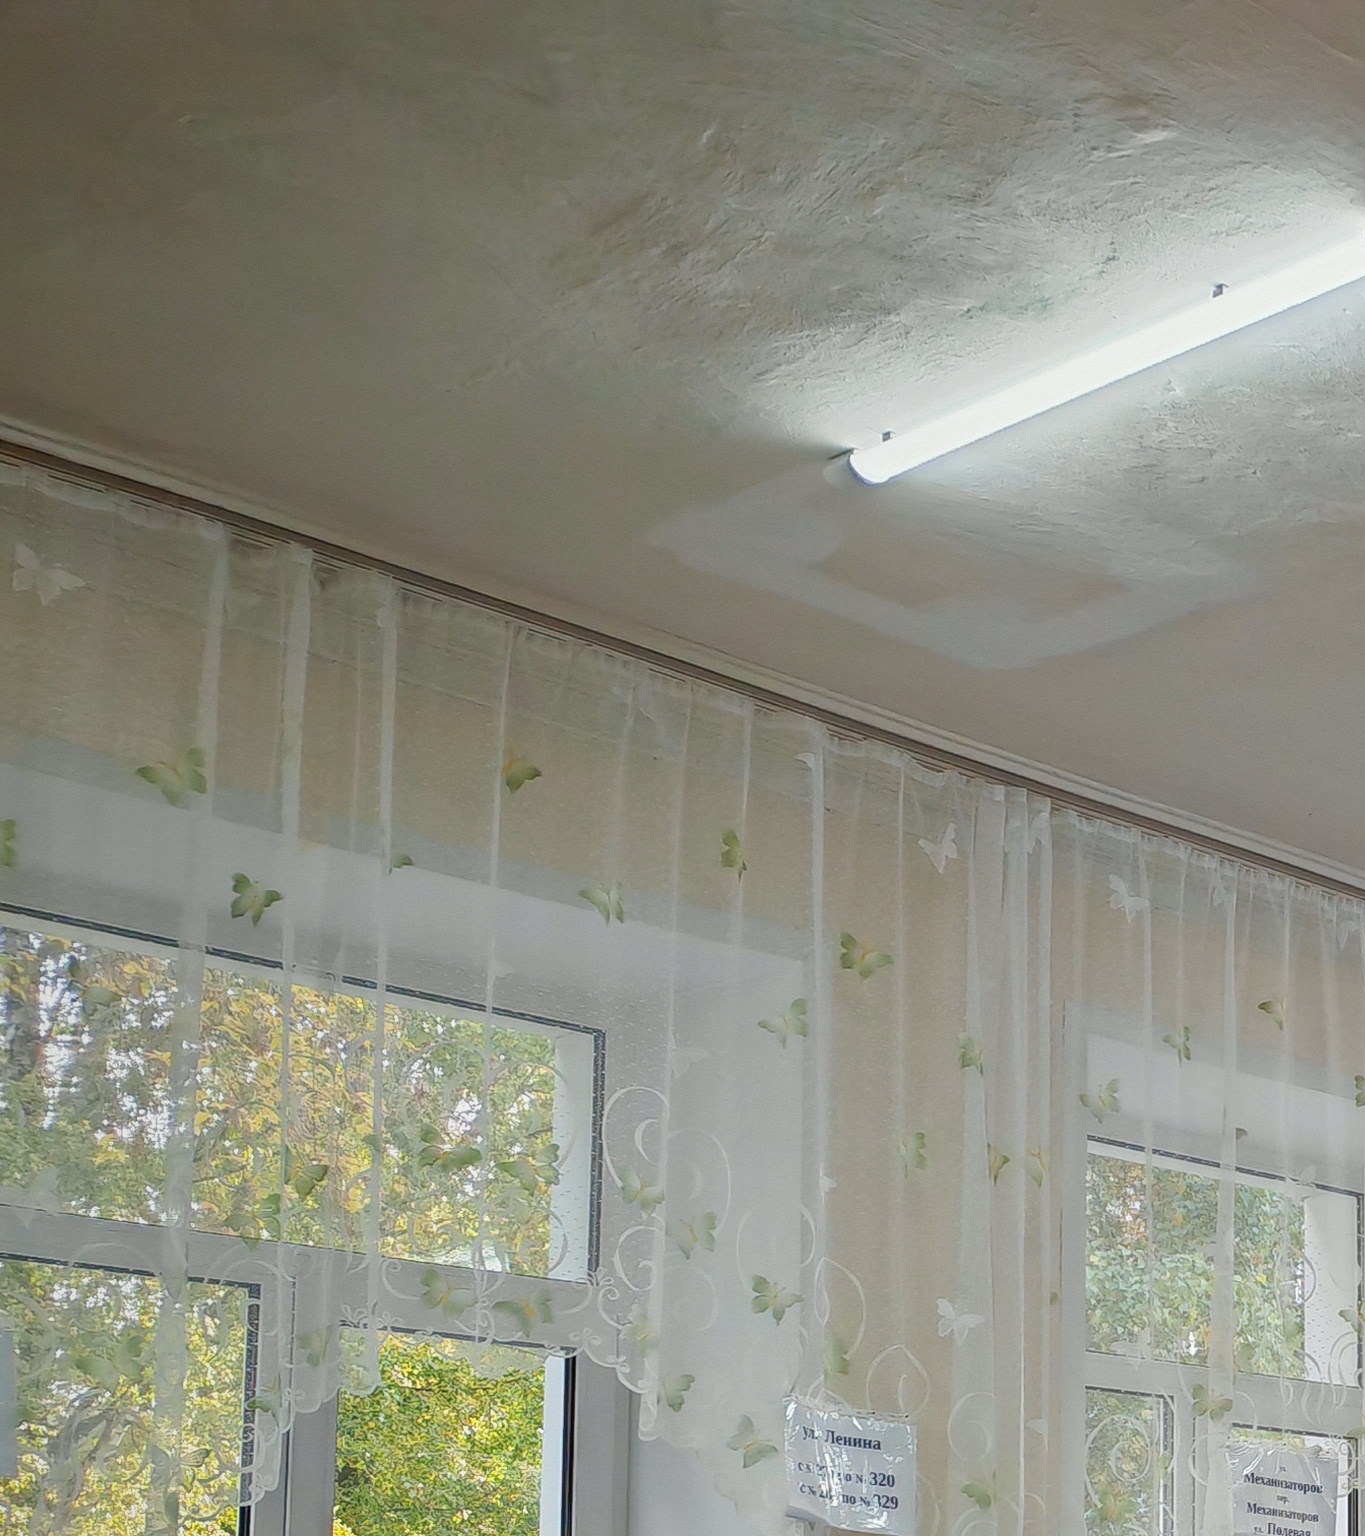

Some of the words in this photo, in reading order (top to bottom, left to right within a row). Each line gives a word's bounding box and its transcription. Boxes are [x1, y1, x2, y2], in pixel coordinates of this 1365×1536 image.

[825, 1429, 882, 1450] Ленина
[869, 1472, 895, 1487] 320
[873, 1494, 899, 1510] 329
[1246, 1502, 1319, 1523] Механизаторов
